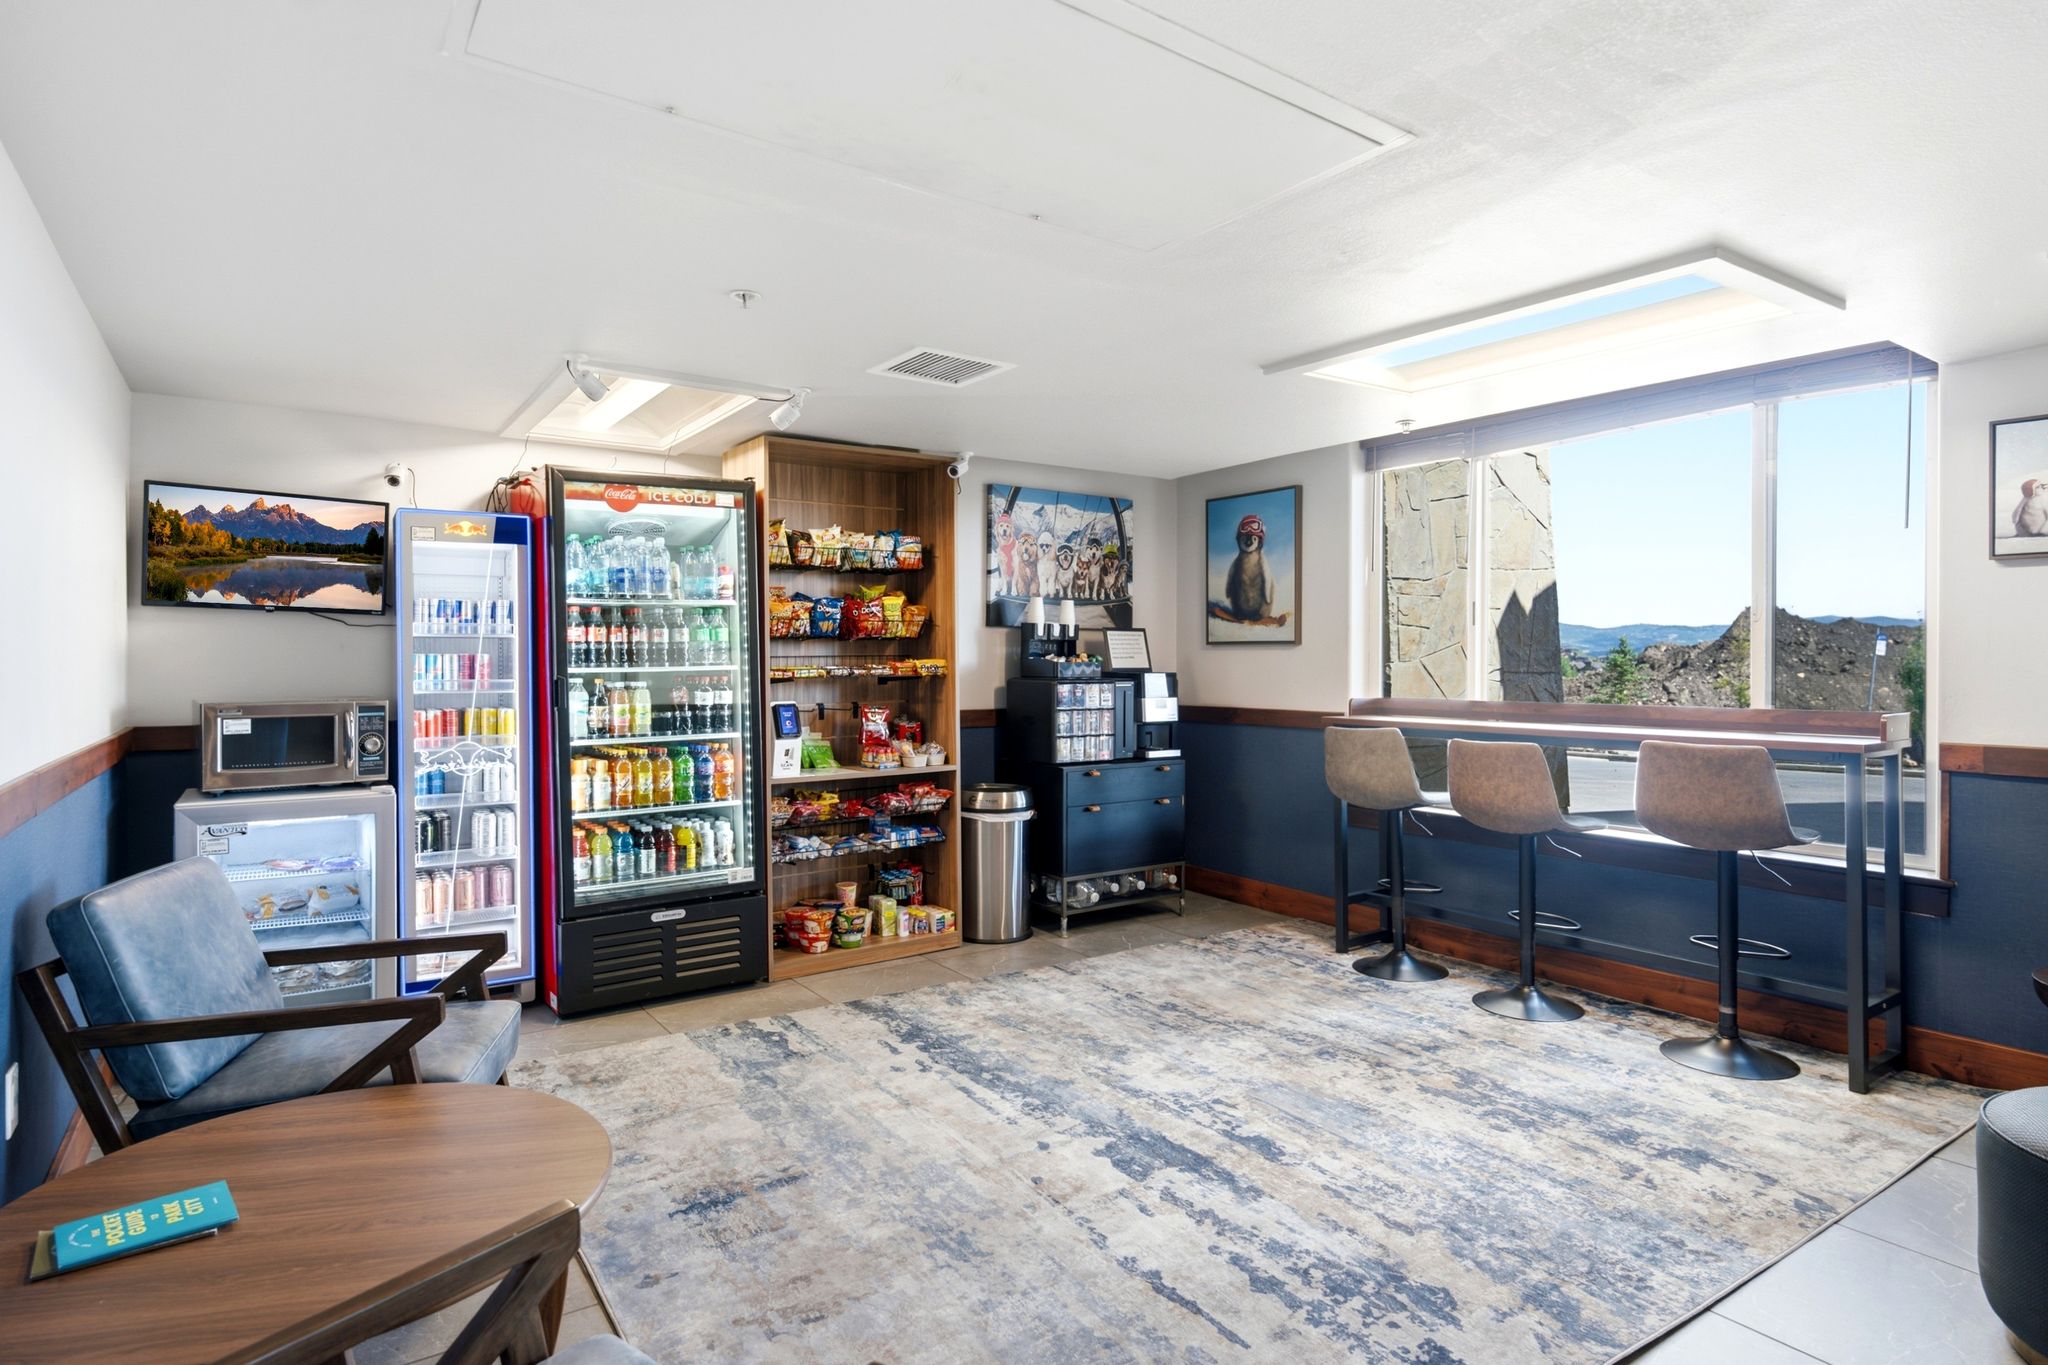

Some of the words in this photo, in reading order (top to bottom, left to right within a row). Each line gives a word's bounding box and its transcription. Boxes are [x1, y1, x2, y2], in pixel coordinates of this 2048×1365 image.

[604, 488, 637, 500] Coca-Cola
[648, 491, 671, 502] ICE
[675, 493, 711, 505] COLD
[162, 1200, 184, 1224] PARK
[184, 1198, 204, 1216] CITY
[102, 1213, 125, 1246] POCKET
[124, 1208, 147, 1236] GUIDE
